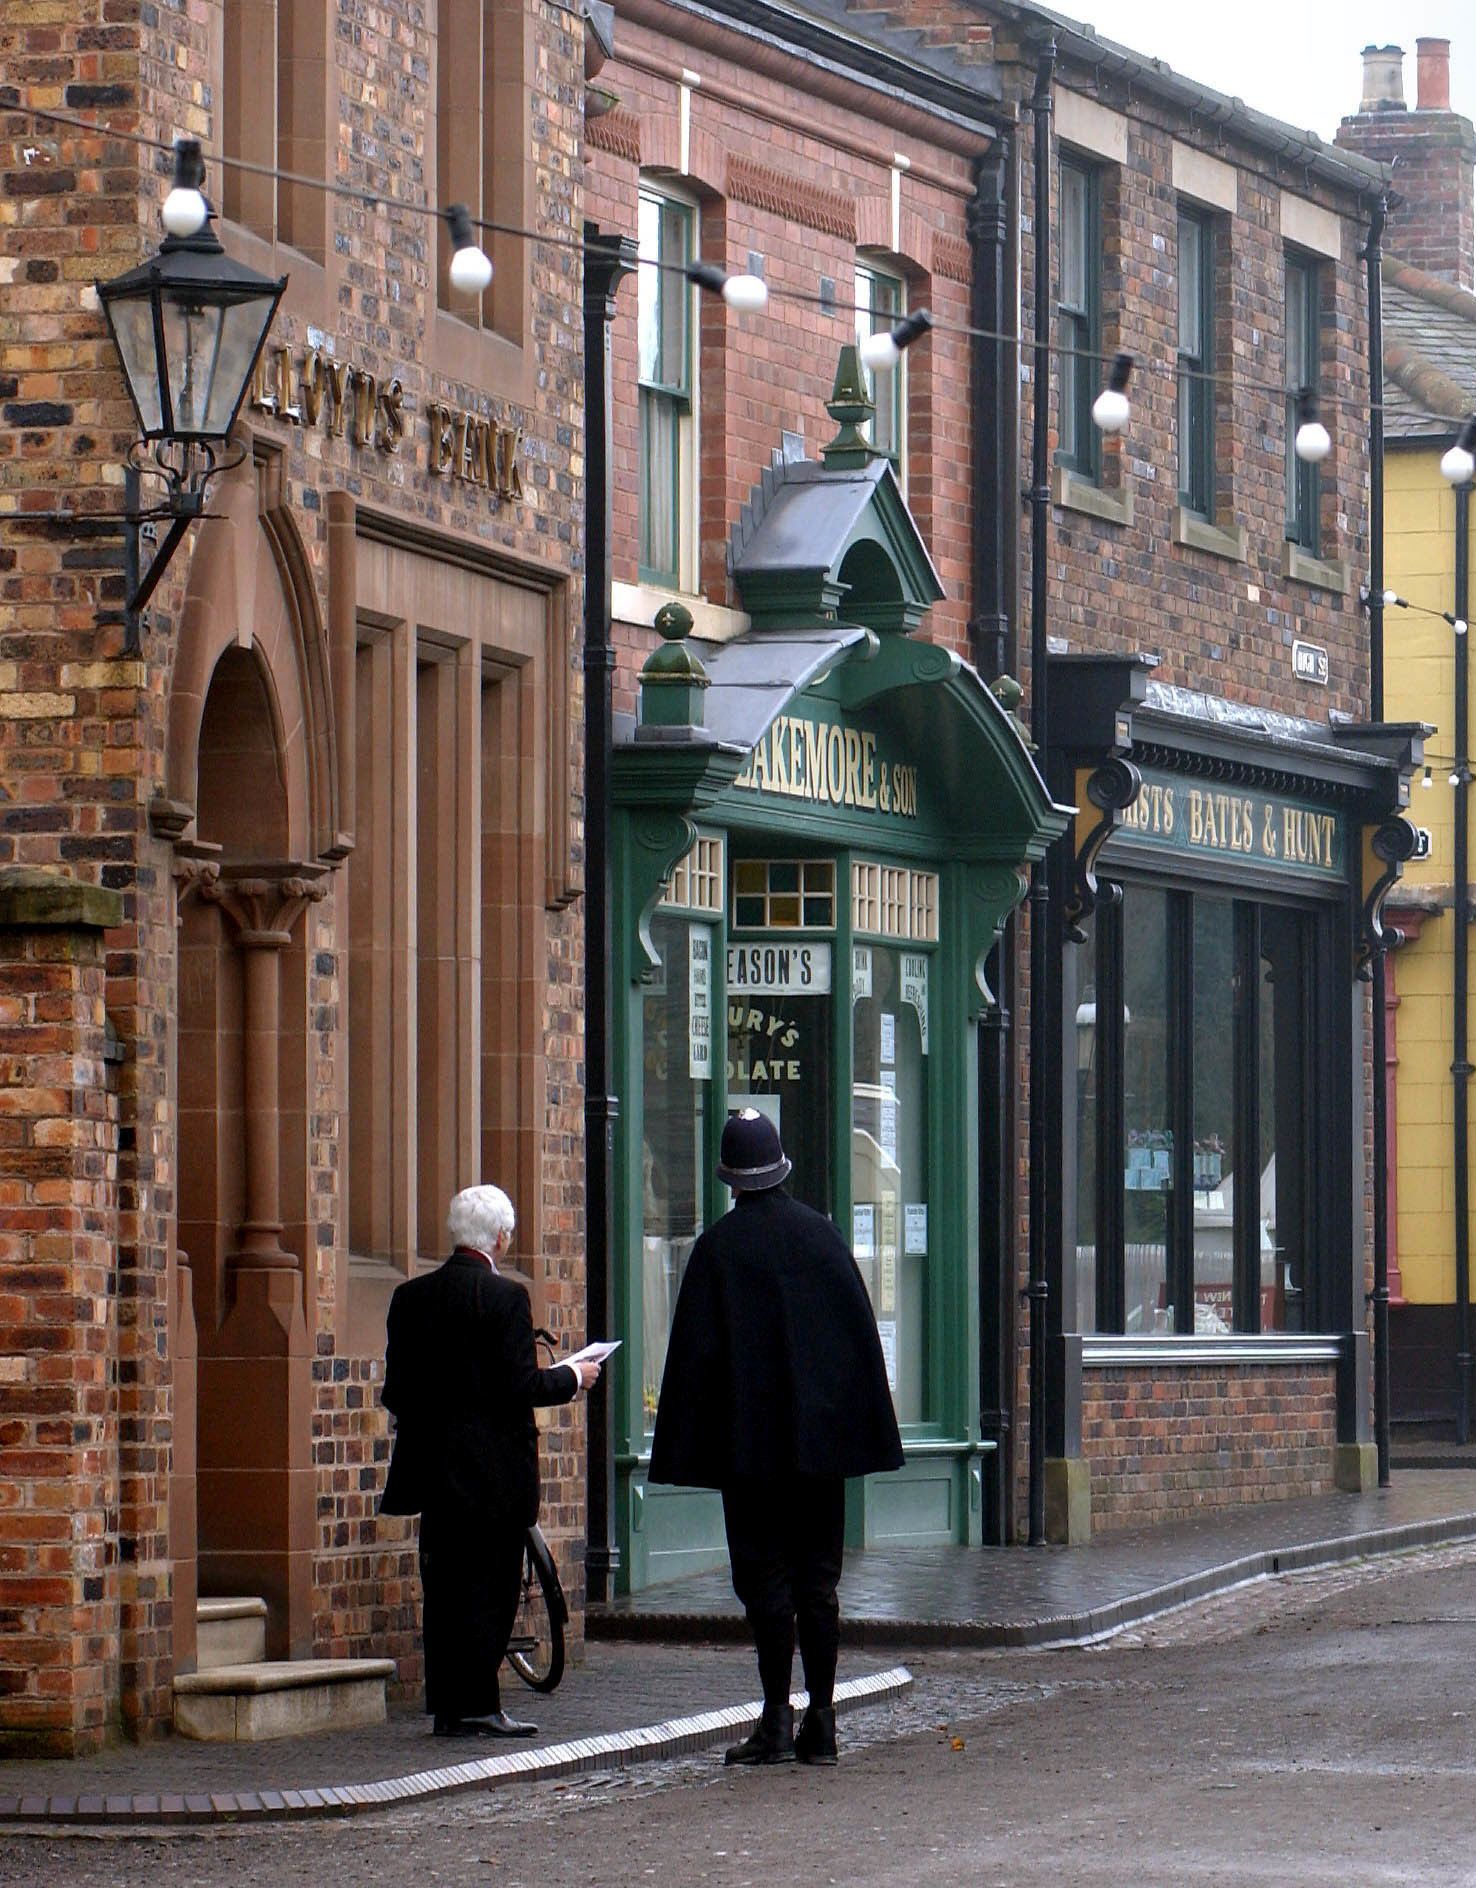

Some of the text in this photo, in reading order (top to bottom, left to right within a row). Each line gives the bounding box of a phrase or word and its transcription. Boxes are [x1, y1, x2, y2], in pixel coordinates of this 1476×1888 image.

[428, 402, 523, 499] BANK
[879, 760, 891, 812] &
[892, 762, 919, 818] SON
[1189, 788, 1253, 851] BATES
[1261, 804, 1277, 857] &
[1282, 806, 1336, 868] HUNT
